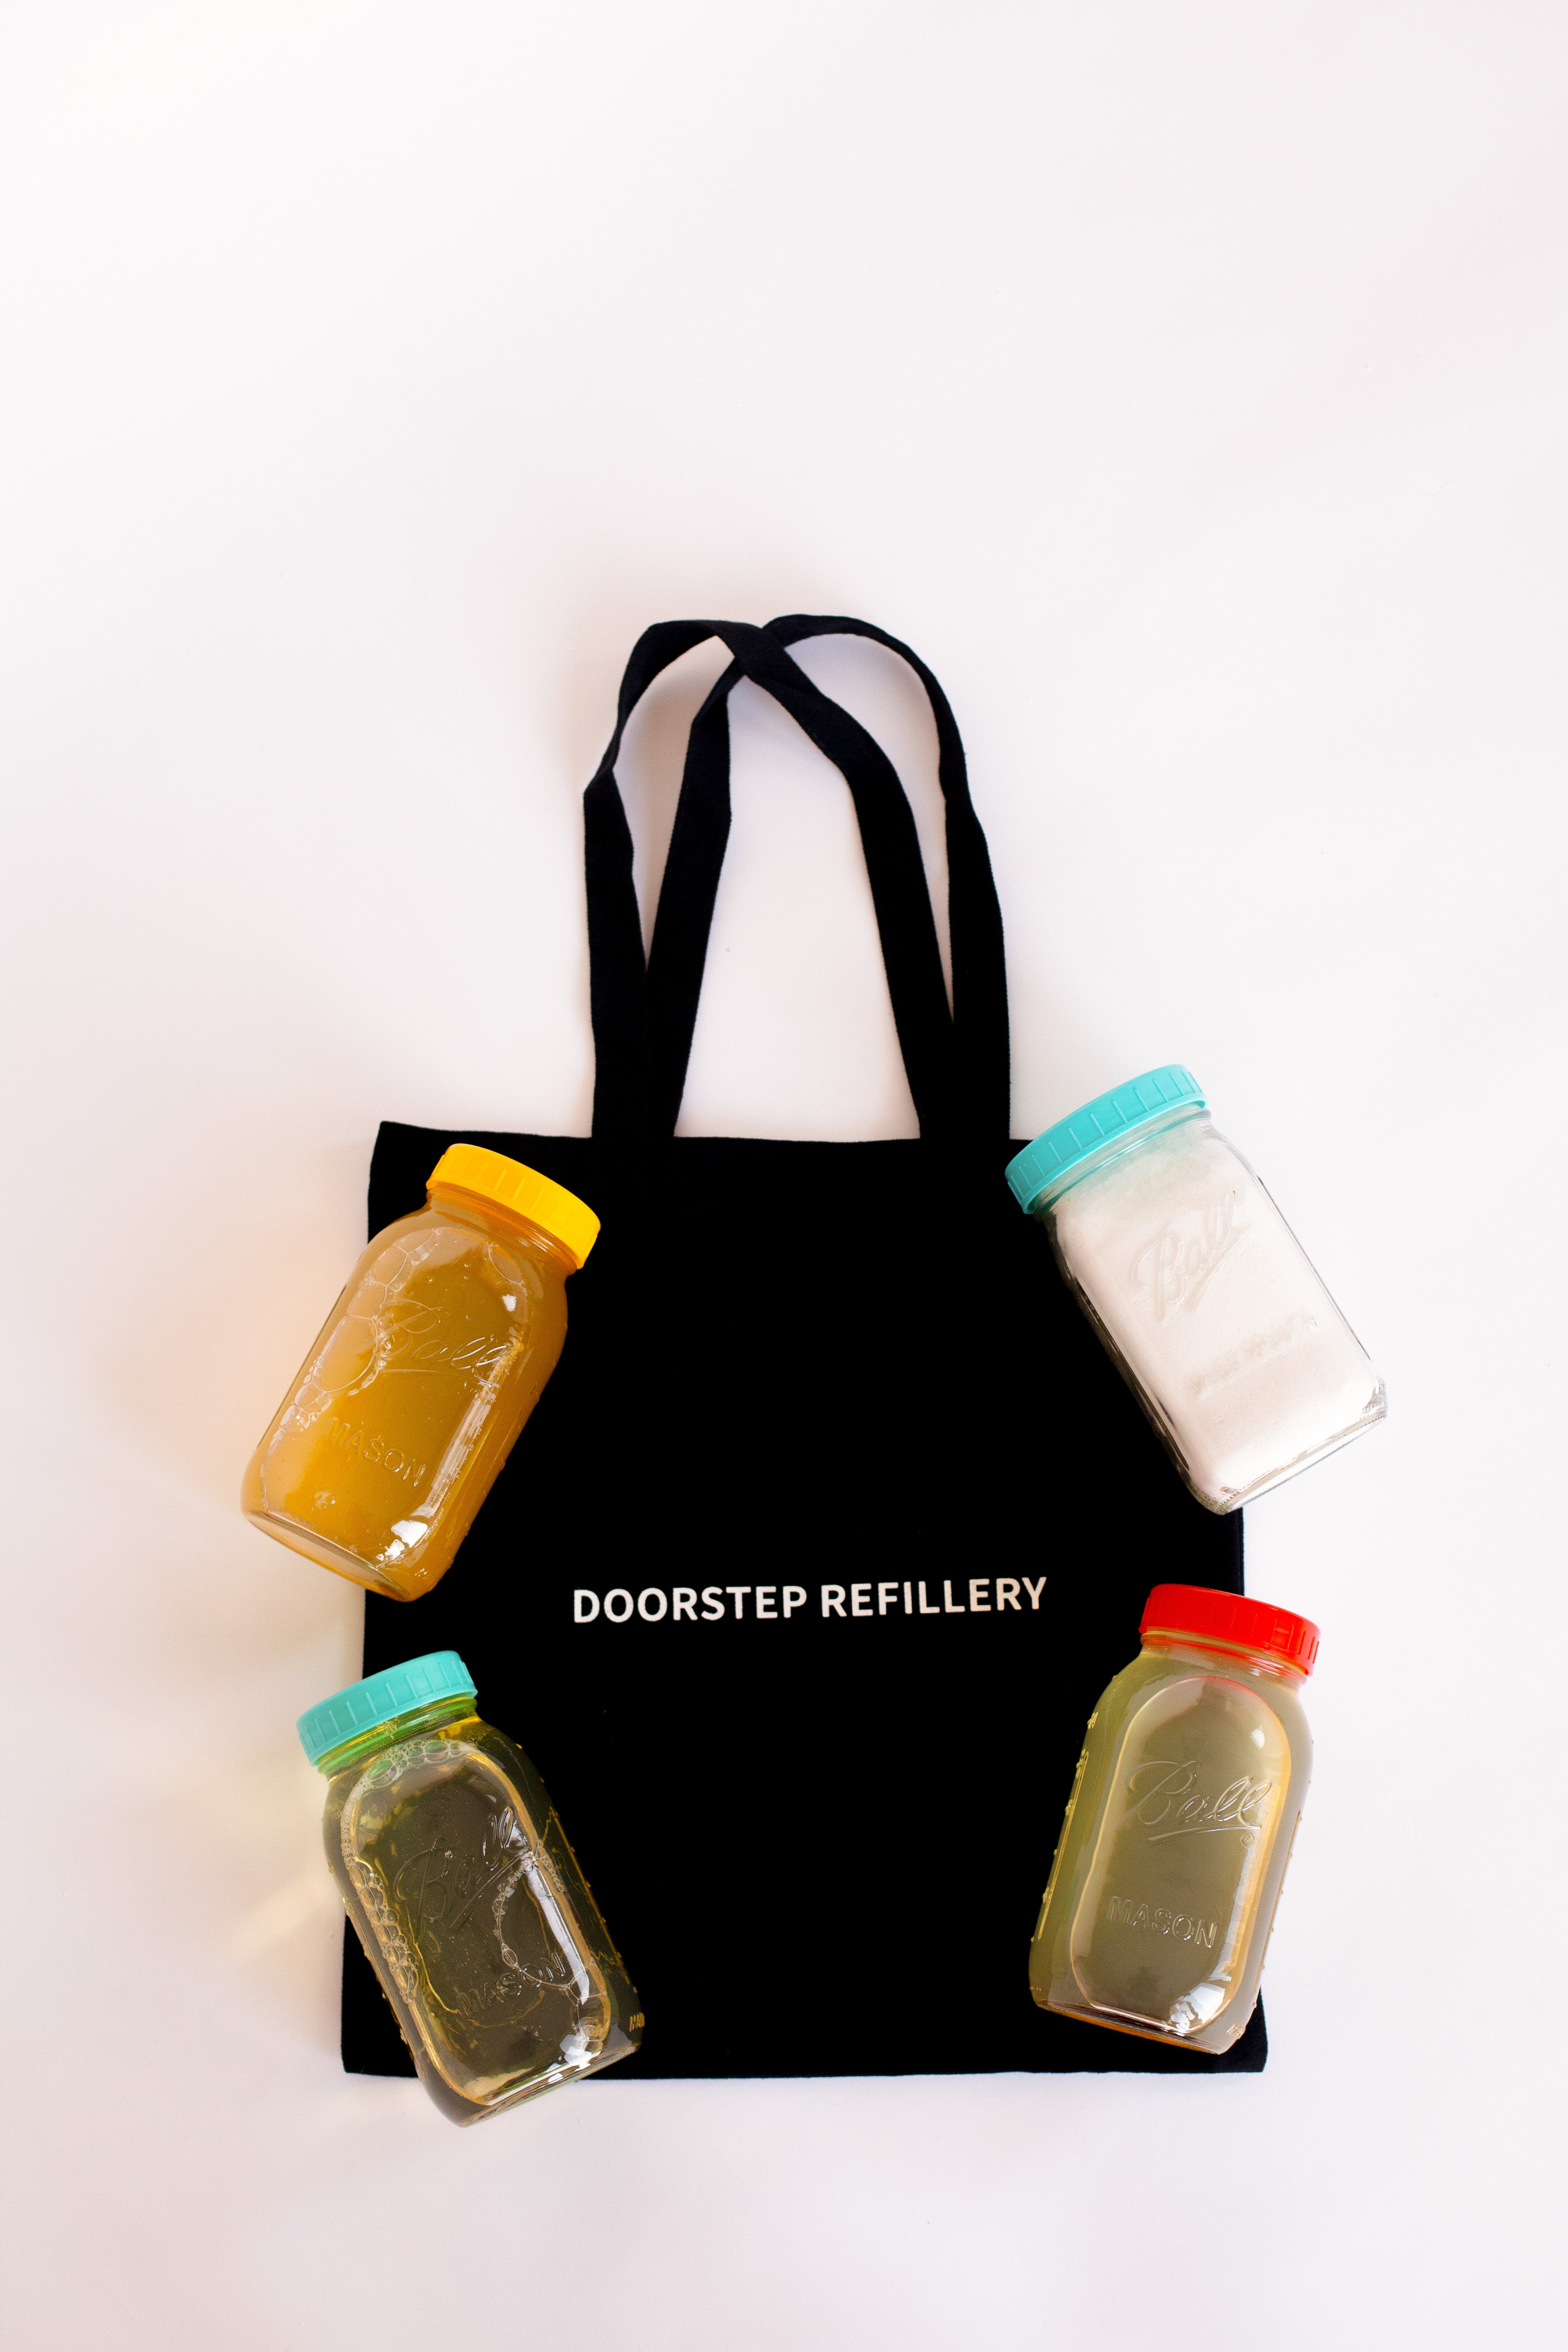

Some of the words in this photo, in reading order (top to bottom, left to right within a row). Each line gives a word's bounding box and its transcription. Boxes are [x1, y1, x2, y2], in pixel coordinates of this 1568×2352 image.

[321, 1417, 426, 1486] MASON
[574, 1585, 807, 1623] DOORSTEP
[821, 1576, 1047, 1618] REFILLERY
[1116, 1760, 1271, 1841] Ball
[1107, 1896, 1217, 1949] MASON
